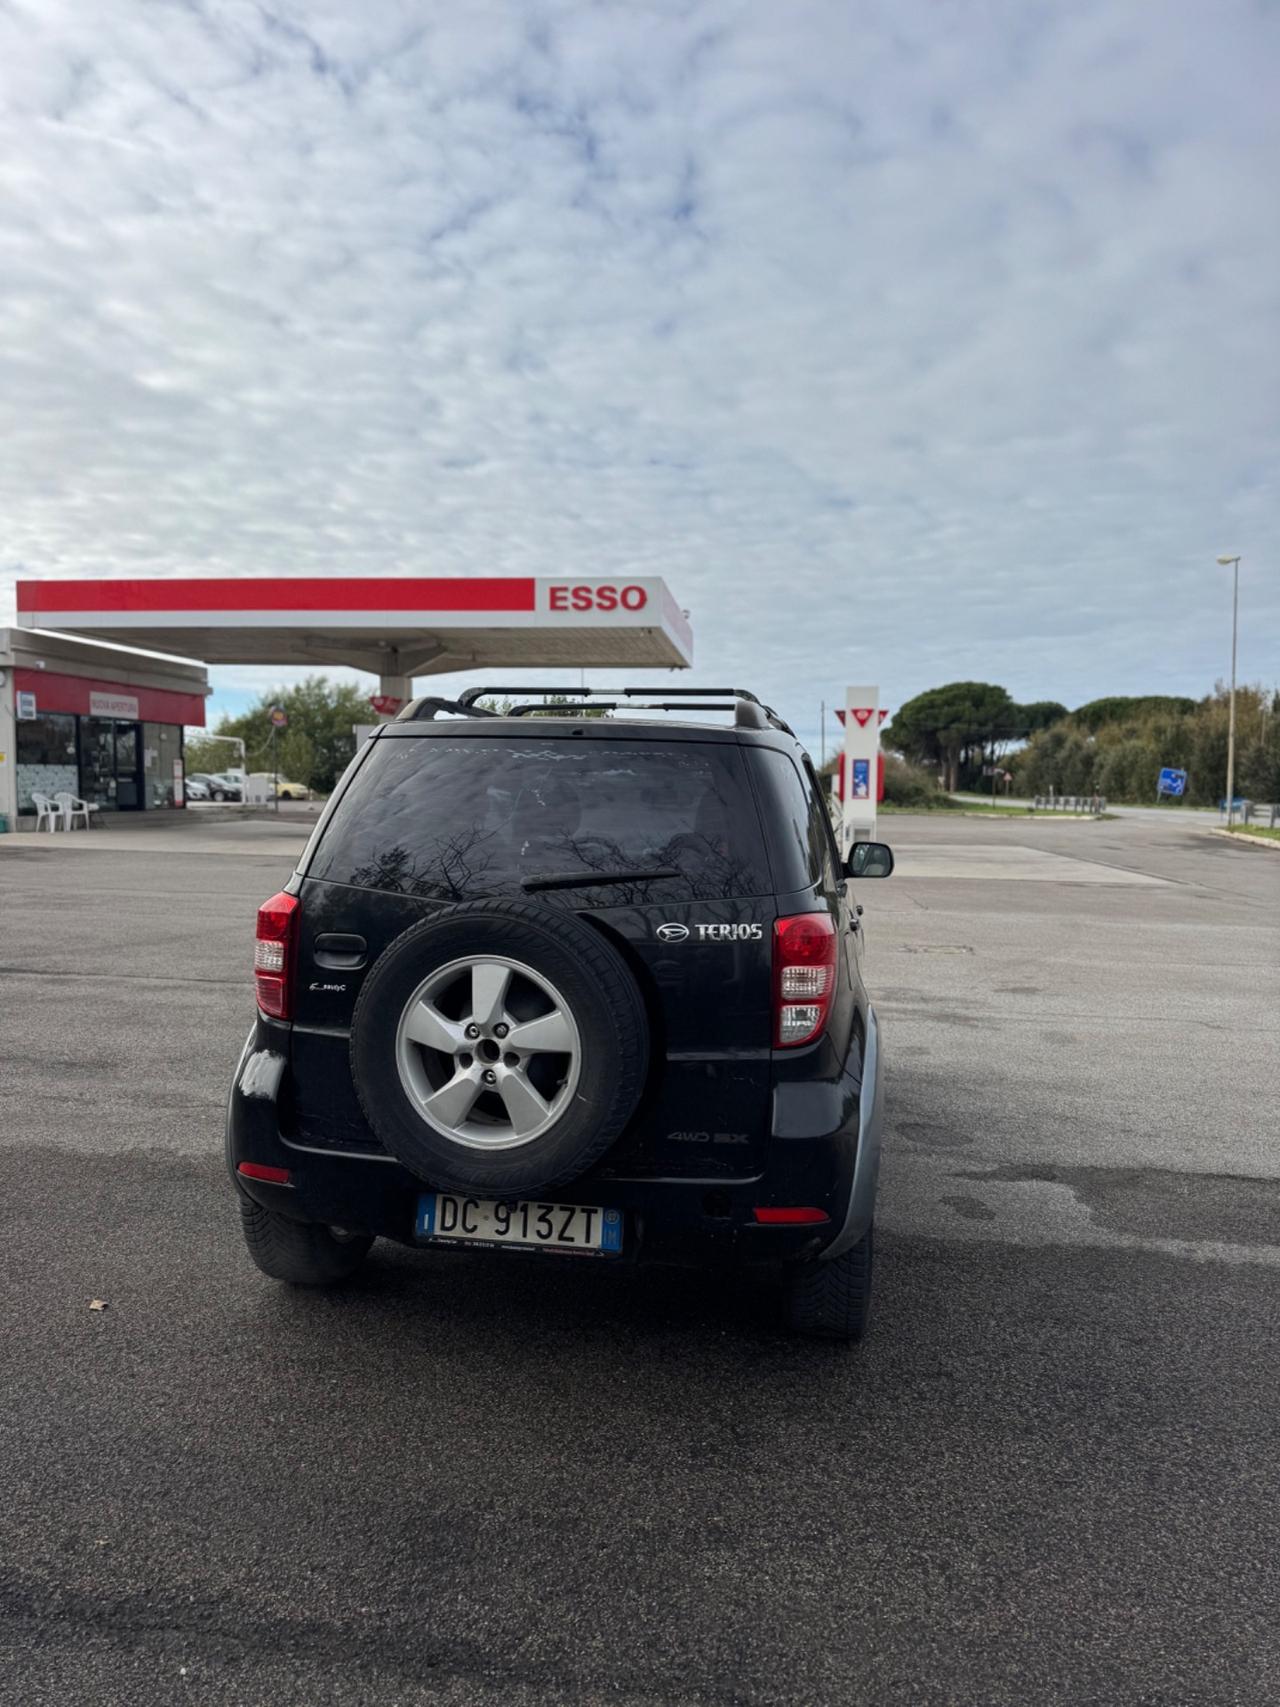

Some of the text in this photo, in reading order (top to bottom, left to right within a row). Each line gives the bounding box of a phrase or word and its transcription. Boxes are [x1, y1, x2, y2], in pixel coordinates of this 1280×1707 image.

[549, 585, 648, 611] ESSO
[694, 923, 763, 940] TERIOS
[667, 1131, 710, 1143] 4WD
